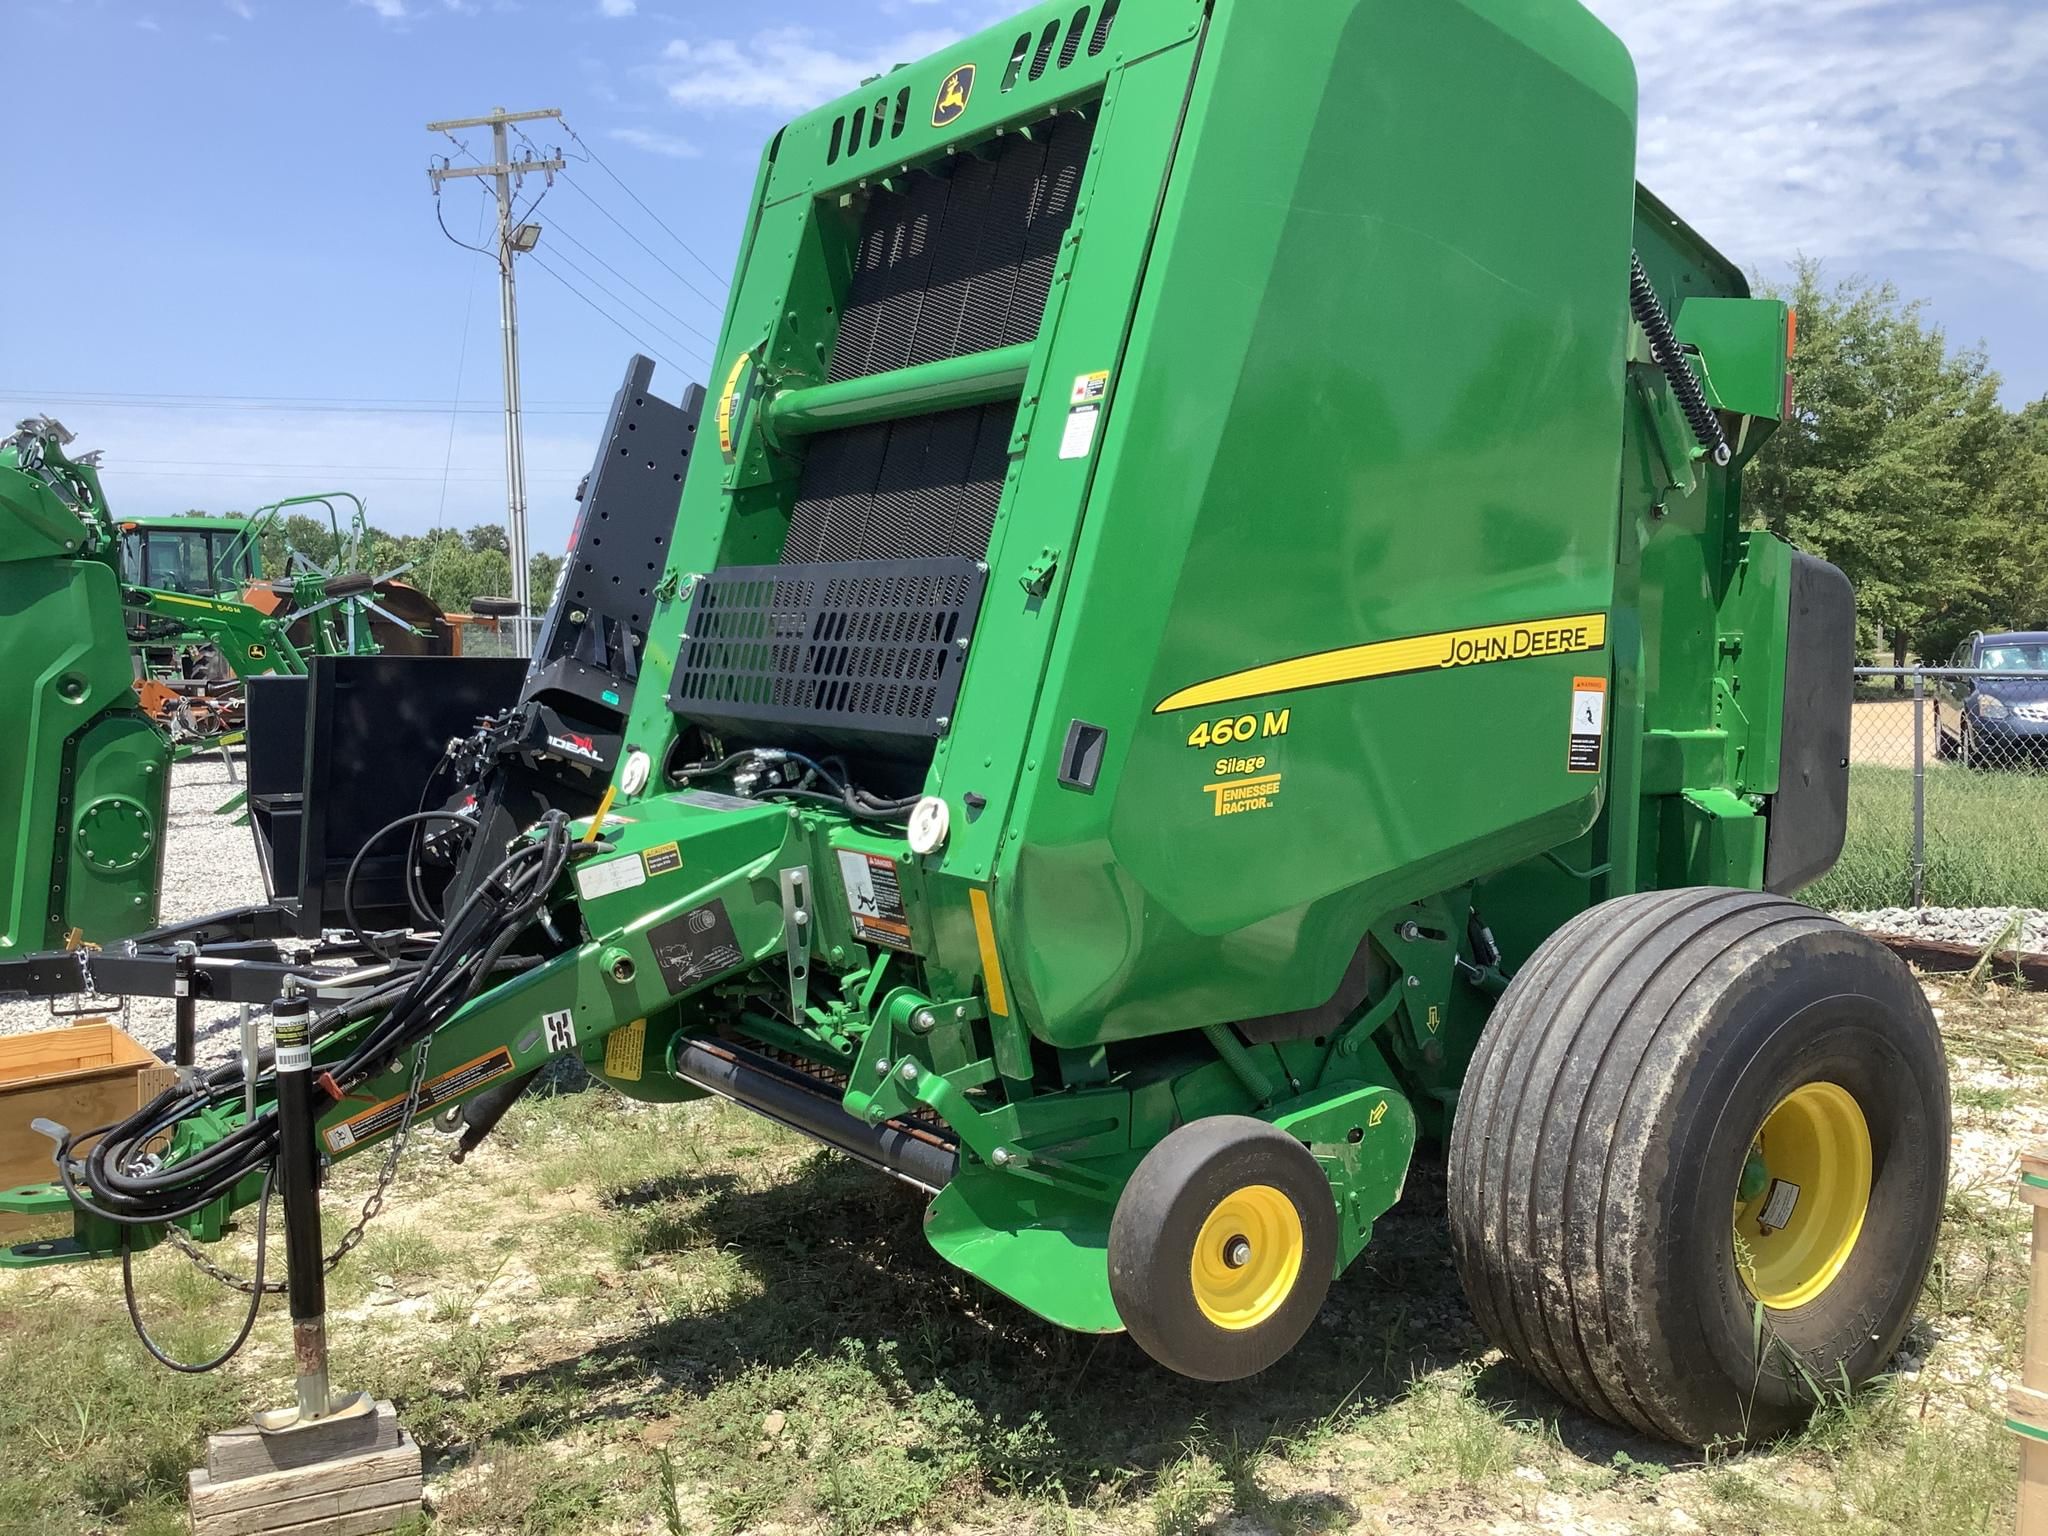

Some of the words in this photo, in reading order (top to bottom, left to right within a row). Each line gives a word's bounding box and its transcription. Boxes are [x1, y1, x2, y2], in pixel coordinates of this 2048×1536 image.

[1441, 636, 1507, 664] JOHN
[1513, 627, 1587, 654] DEERE
[1187, 713, 1258, 749] 460
[1261, 708, 1291, 738] M
[547, 735, 604, 762] IDEAL
[1214, 755, 1266, 776] Silage
[1203, 773, 1281, 805] TENNESSEE
